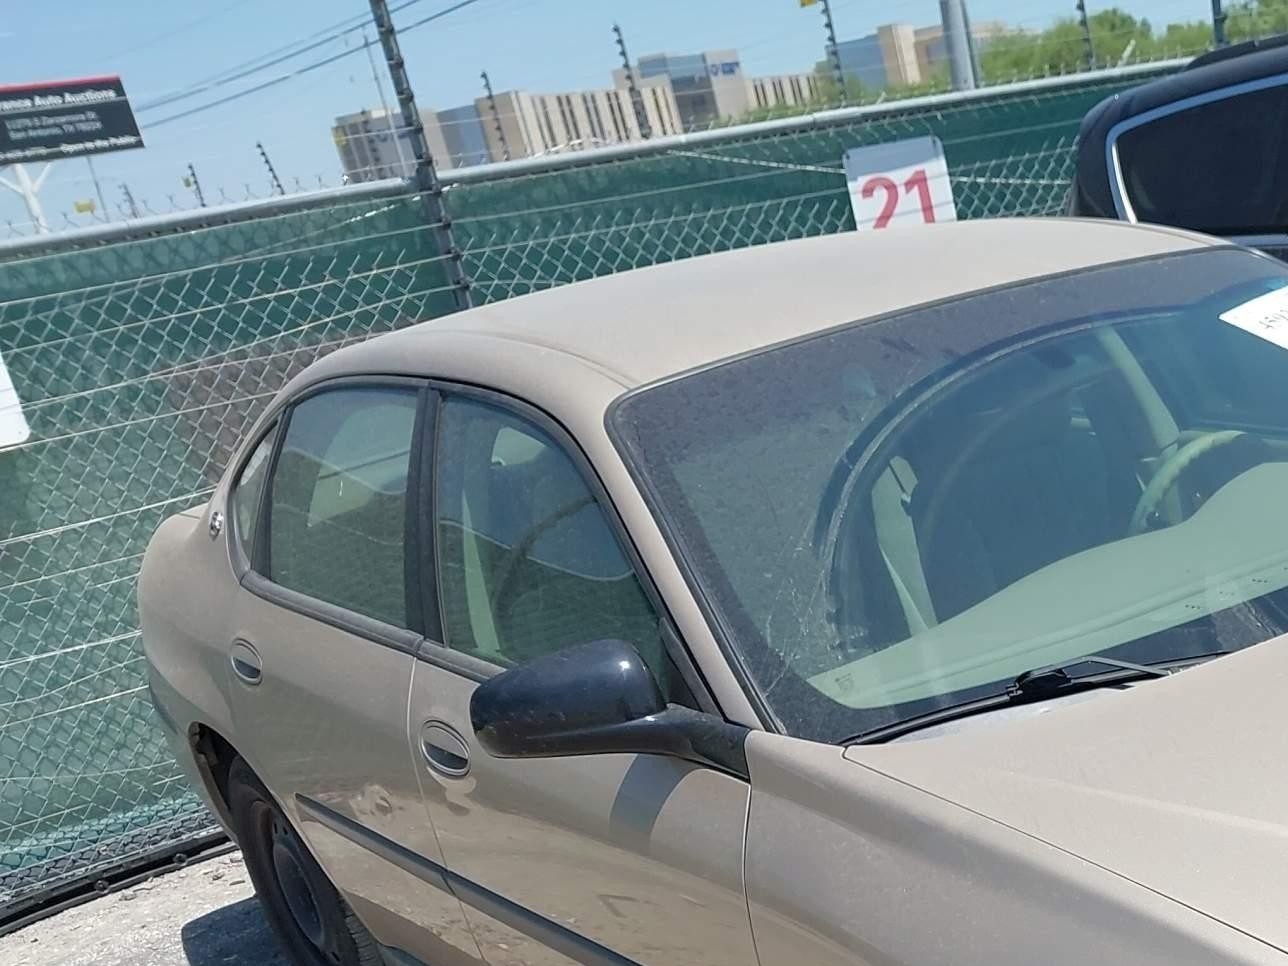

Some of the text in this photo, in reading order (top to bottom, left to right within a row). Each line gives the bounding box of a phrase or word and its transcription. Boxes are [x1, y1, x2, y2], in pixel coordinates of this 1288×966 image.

[34, 94, 62, 106] Auto
[64, 89, 117, 104] Auctions
[861, 168, 935, 229] 21
